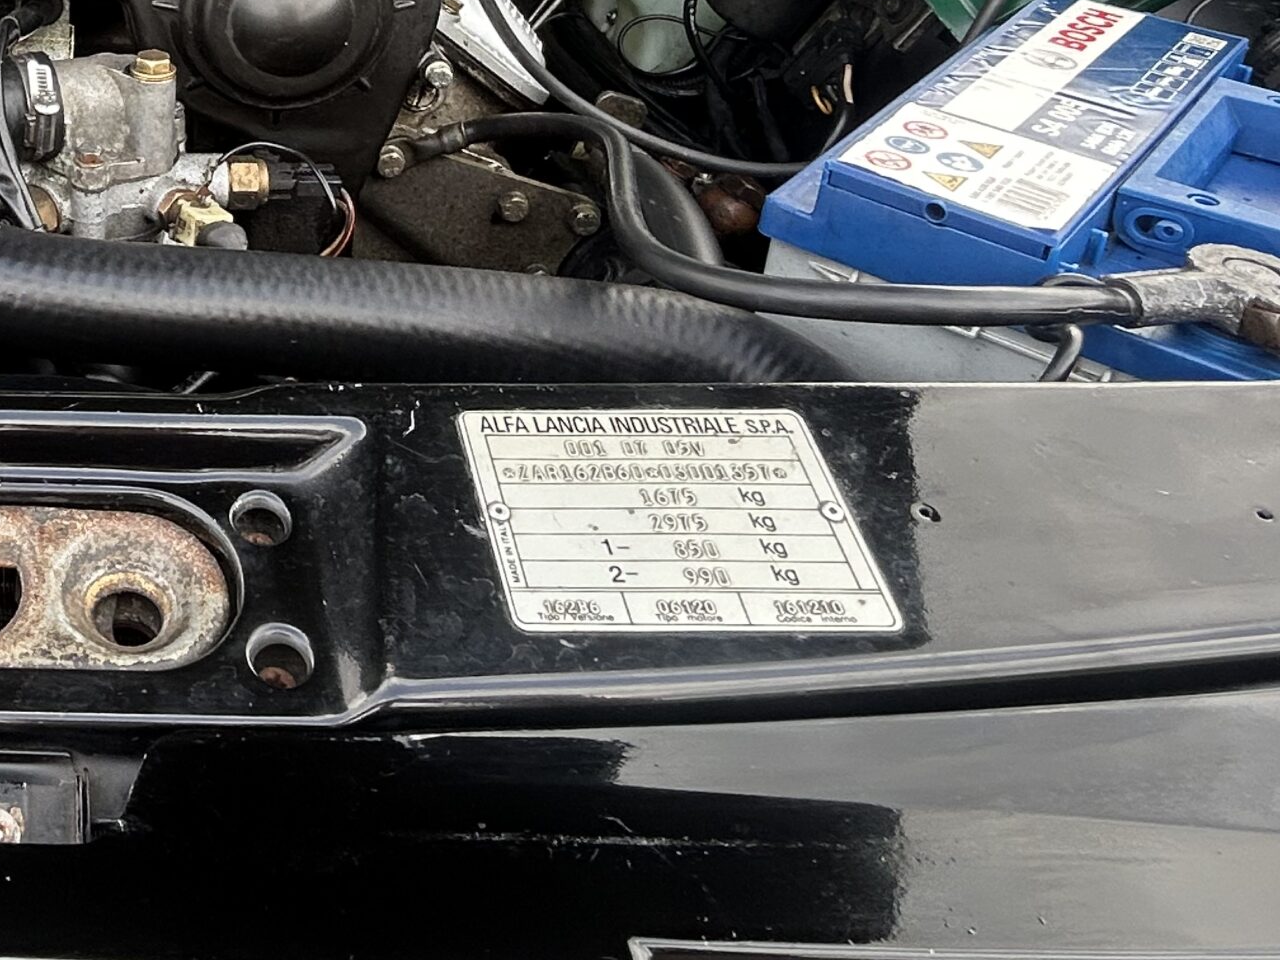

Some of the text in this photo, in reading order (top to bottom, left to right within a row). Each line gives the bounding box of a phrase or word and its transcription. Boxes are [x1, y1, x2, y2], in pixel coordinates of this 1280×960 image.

[1048, 7, 1124, 52] BOSCH
[480, 416, 794, 435] ALFA LANCIA INDUSTRIALE S.P.A.
[737, 487, 766, 507] kg
[748, 512, 777, 532] kg
[504, 546, 513, 556] IN
[673, 540, 721, 559] 850
[759, 538, 788, 558] kg
[507, 558, 521, 584] MADE
[683, 566, 732, 587] 990
[770, 565, 800, 585] kg
